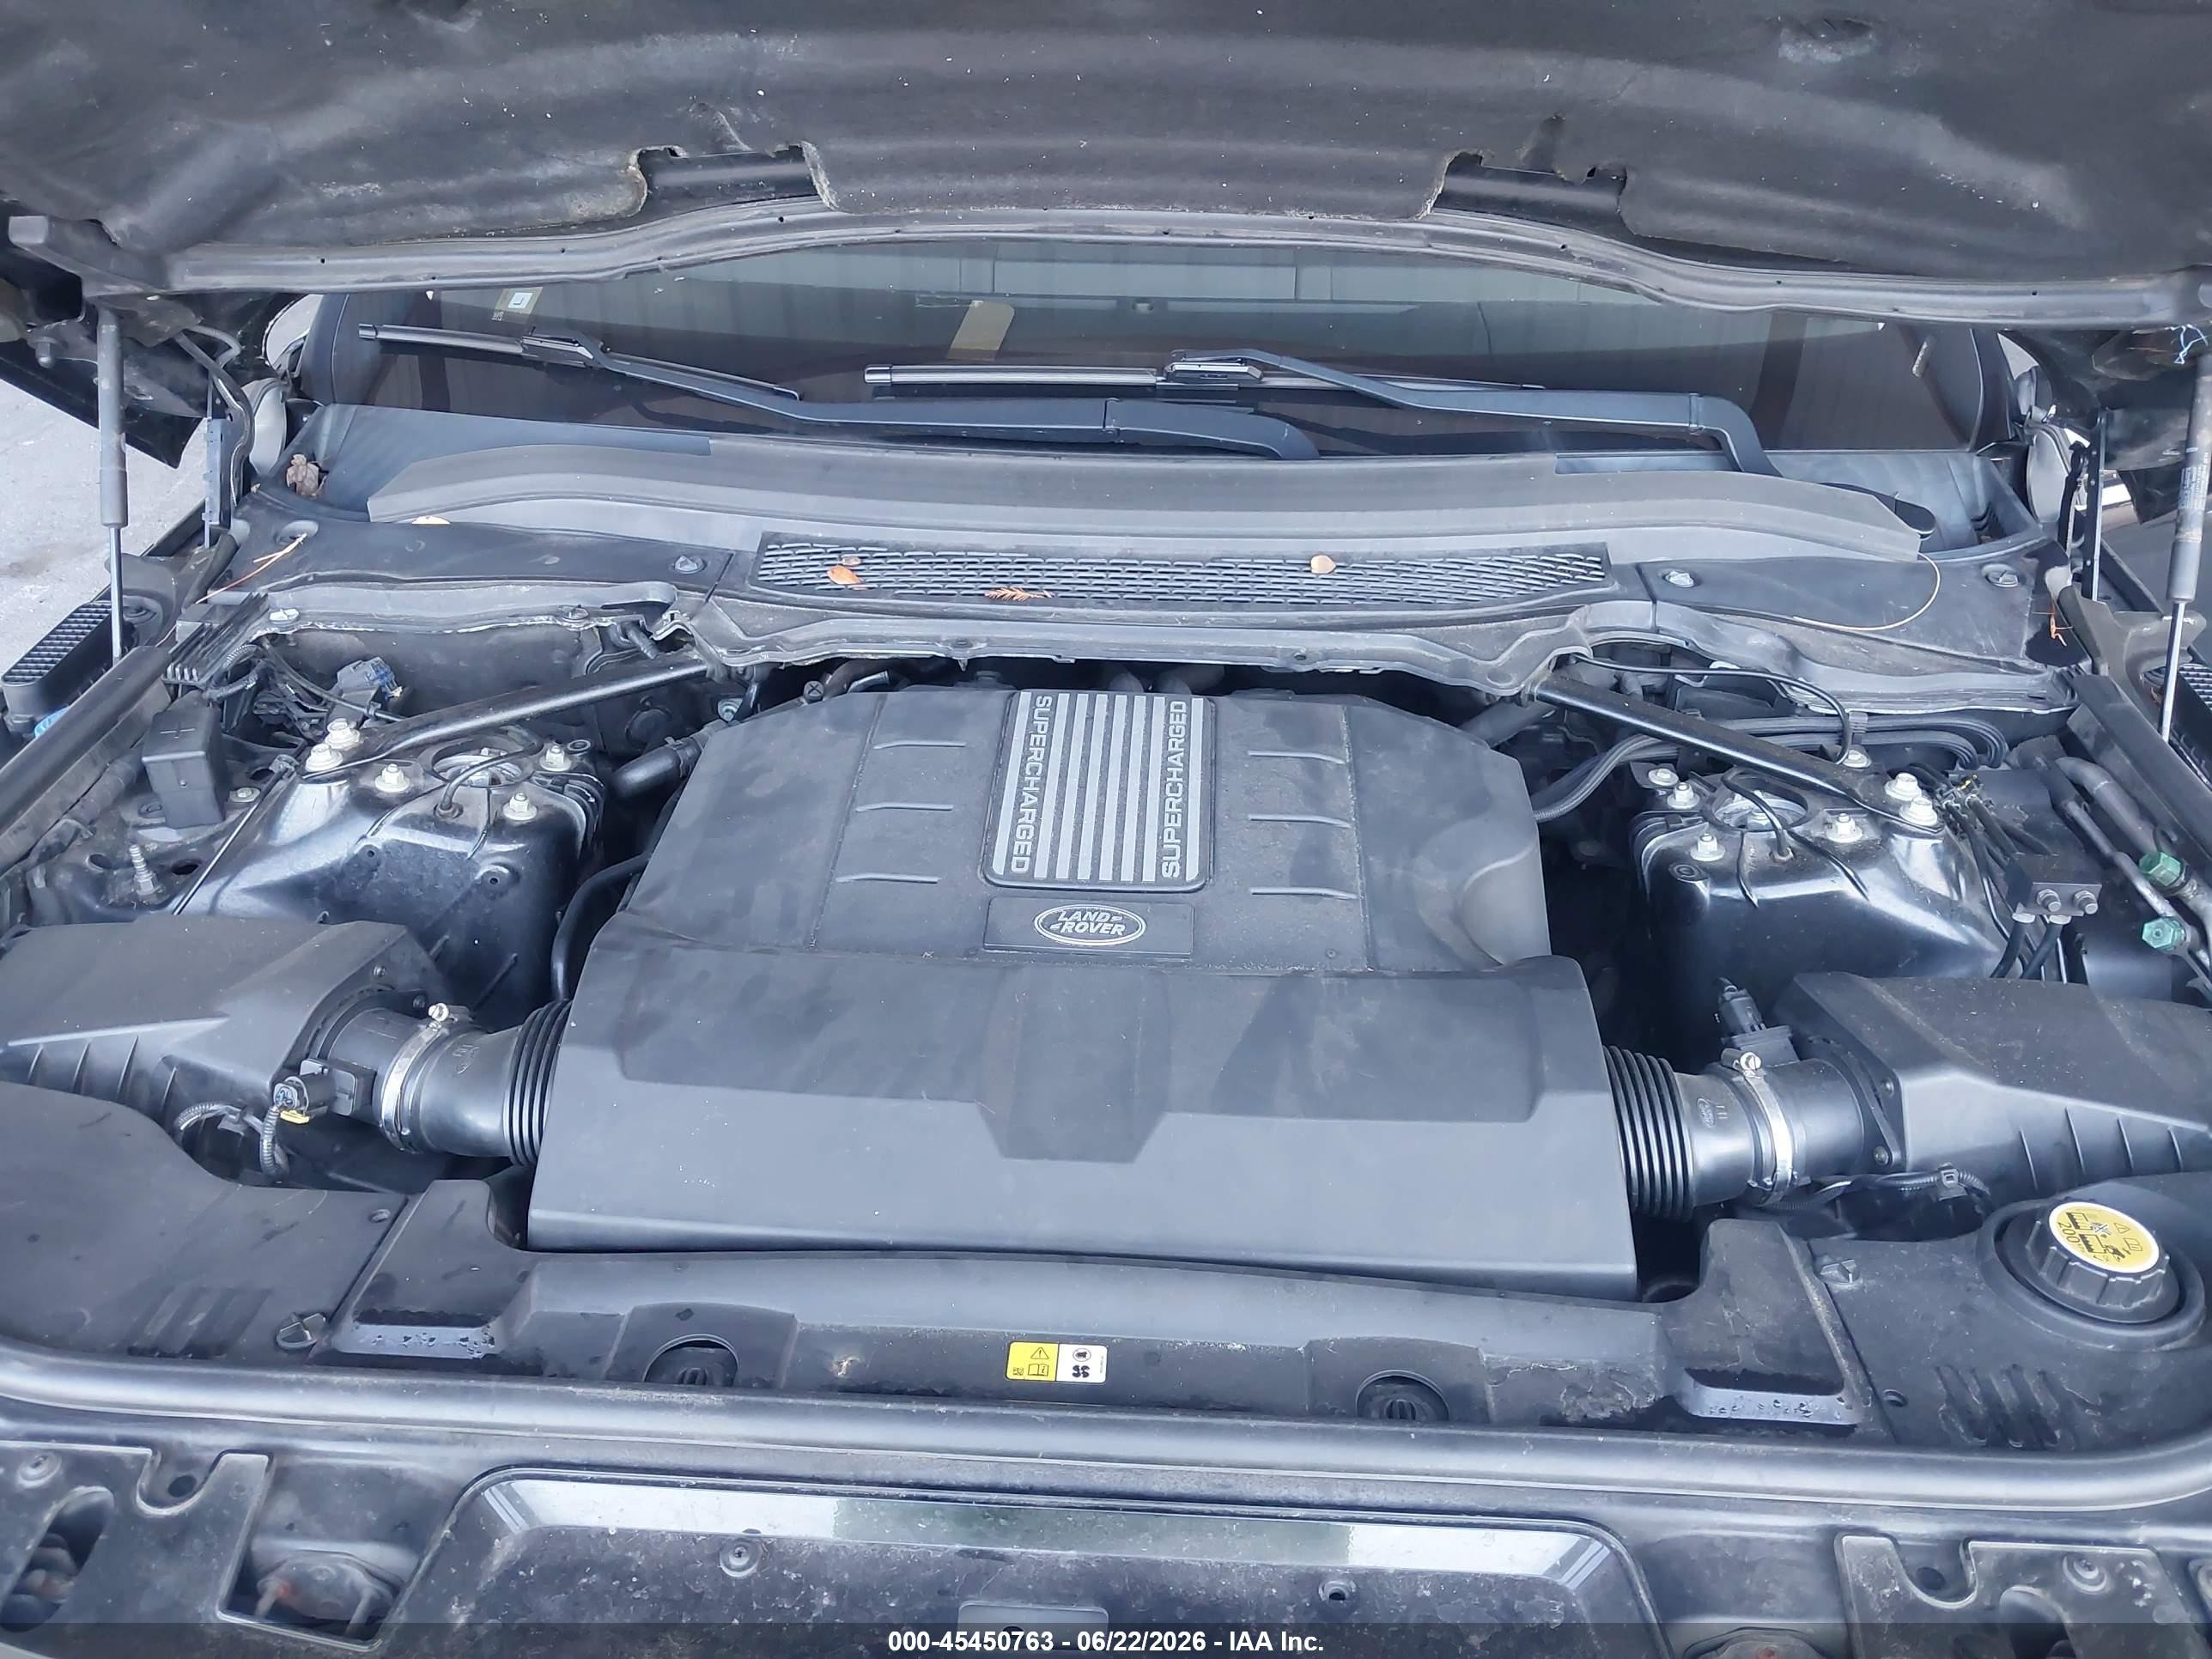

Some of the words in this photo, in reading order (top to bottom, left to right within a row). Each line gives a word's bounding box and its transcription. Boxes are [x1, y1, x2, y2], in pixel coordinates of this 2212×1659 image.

[1011, 695, 1053, 874] SUPERCHARGED
[1162, 700, 1188, 879] SUPERCHARGED
[1058, 910, 1111, 922] LAND
[1060, 921, 1126, 936] ROVER
[2057, 1222, 2080, 1243] 200
